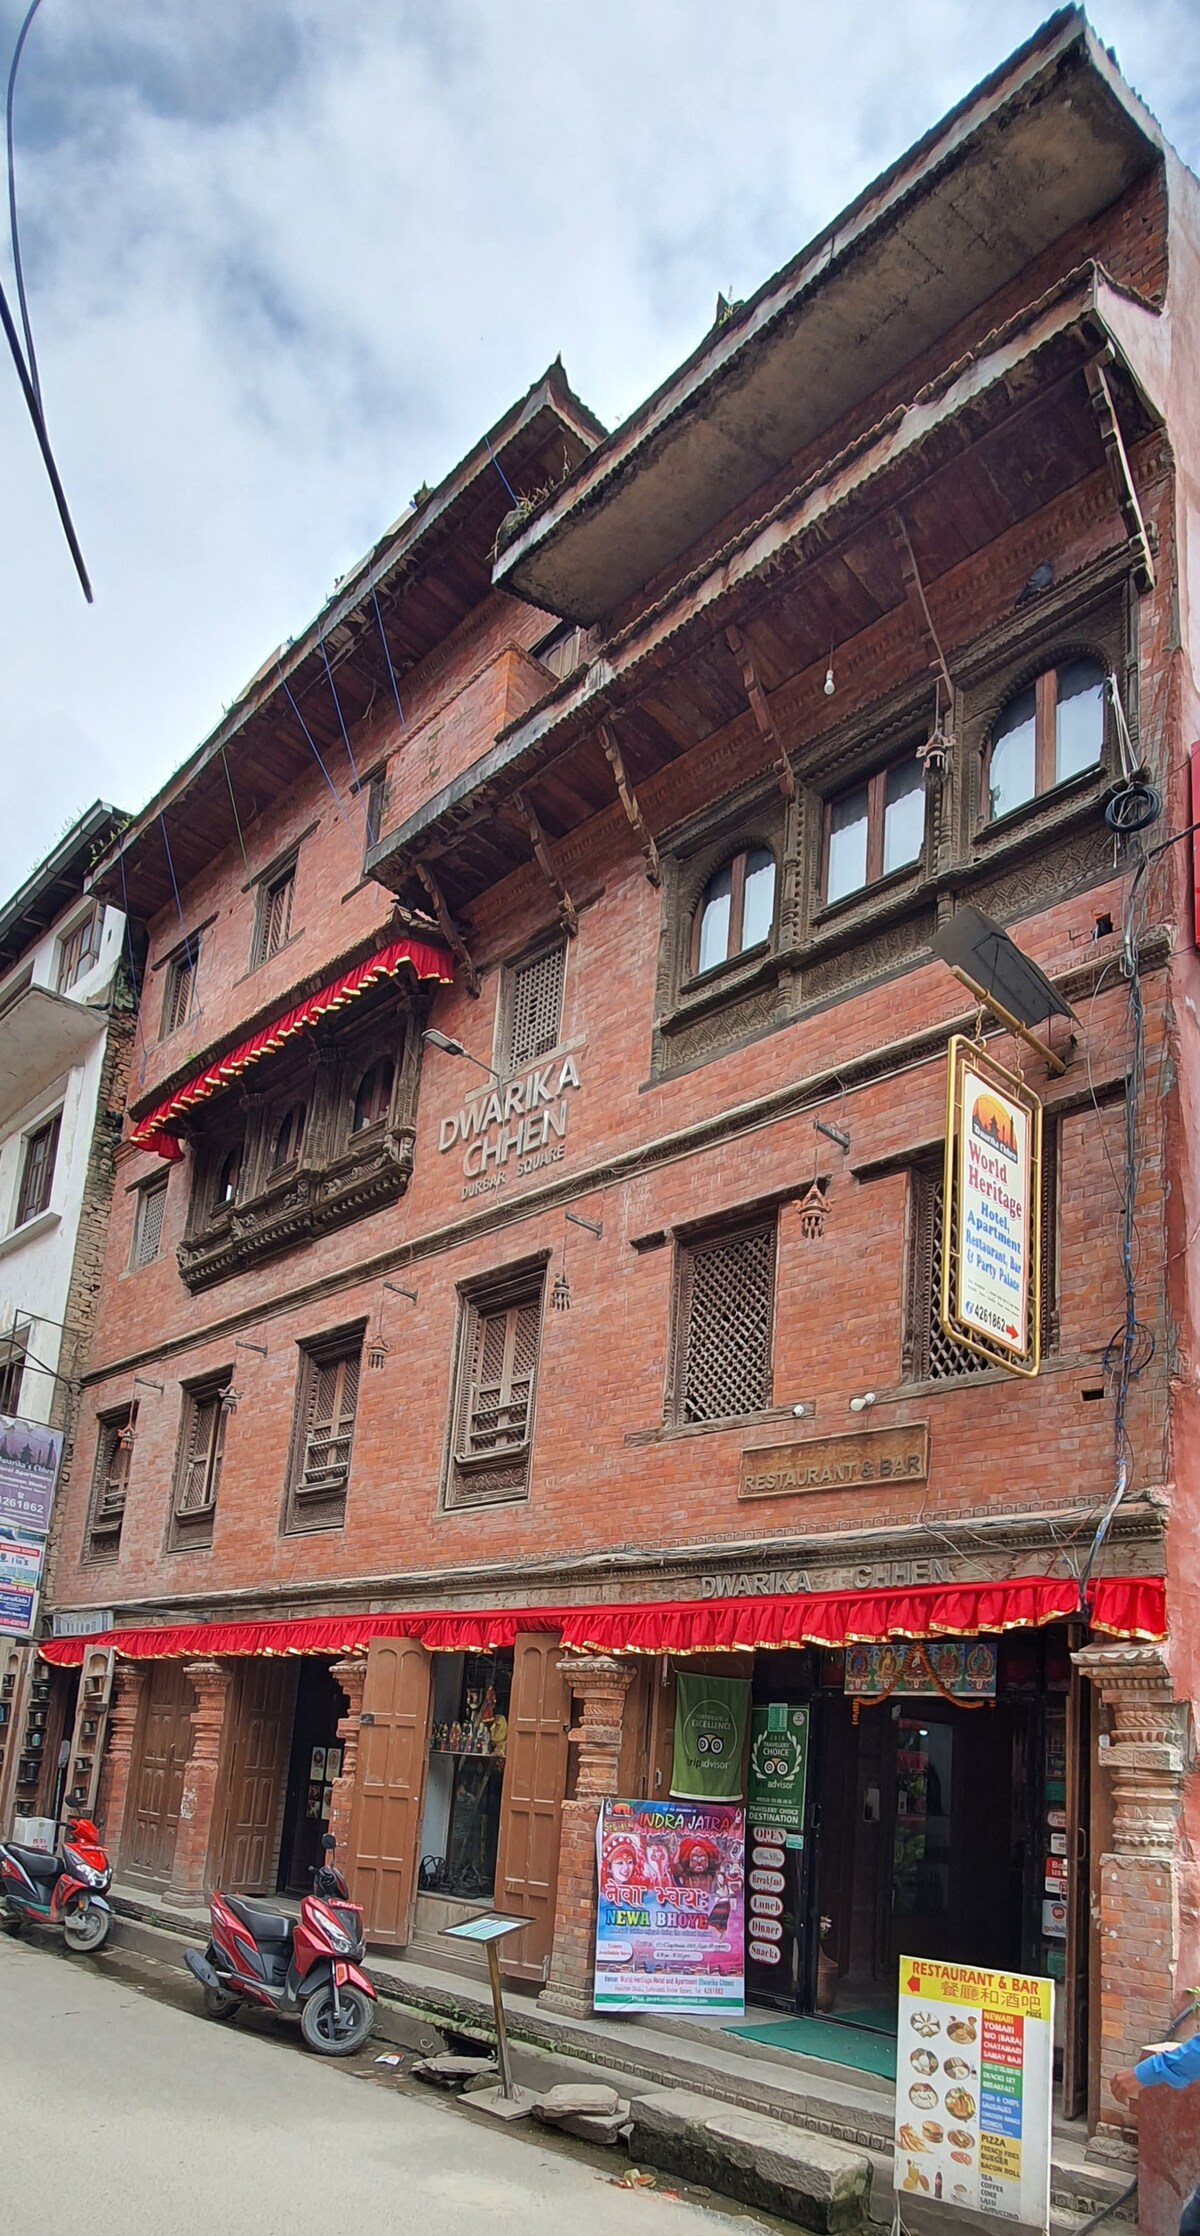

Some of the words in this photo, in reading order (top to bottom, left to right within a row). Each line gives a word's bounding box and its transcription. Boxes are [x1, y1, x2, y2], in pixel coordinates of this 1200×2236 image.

[439, 1055, 581, 1152] DWARIKA
[463, 1100, 567, 1177] CHHEN
[968, 1139, 1008, 1184] World
[461, 1171, 506, 1200] DURBAR
[517, 1144, 565, 1177] SQUARE
[968, 1164, 1022, 1219] Heritage
[981, 1201, 1010, 1233] Hotel,
[967, 1210, 1021, 1254] Apartment
[965, 1229, 1007, 1267] Restaurant,
[1009, 1256, 1021, 1275] Bar
[976, 1253, 997, 1280] Party
[999, 1267, 1020, 1292] Palace
[974, 1305, 1006, 1333] 4261862
[743, 1463, 856, 1492] RESTAURANT
[861, 1461, 873, 1478] &
[879, 1454, 921, 1477] BAR
[701, 1571, 812, 1598] DWARIKA
[853, 1558, 950, 1589] CHHEN
[763, 1748, 790, 1757] CHOICE
[687, 1757, 729, 1770] tripadvisor
[639, 1812, 684, 1830] INDRA
[687, 1815, 731, 1833] JATRA
[749, 1812, 799, 1824] DESTINATION
[756, 1828, 784, 1841] OPEN
[752, 1873, 782, 1887] Breakfast
[753, 1897, 781, 1912] Lunch
[606, 1909, 650, 1927] NEWA
[656, 1911, 709, 1930] BHOYE
[752, 1920, 779, 1935] Dinner
[751, 1944, 778, 1959] Snacks
[912, 1961, 994, 1987] RESTAURANT
[998, 1976, 1007, 1991] &
[1012, 1978, 1039, 1995] BAR
[941, 1980, 1042, 2012] 餐廳和酒吧
[984, 2011, 1014, 2024] NEWARI
[1025, 2010, 1042, 2019] PRICE
[984, 2021, 1014, 2034] YOMARI
[984, 2031, 996, 2040] WO
[983, 2051, 1006, 2061] SAMAY
[1007, 2055, 1022, 2065] BAJI
[981, 2133, 1006, 2148] PIZZA
[980, 2153, 1009, 2166] BURGER
[981, 2145, 1003, 2157] FRENCH
[1004, 2150, 1020, 2160] FRIES
[980, 2162, 1003, 2173] BACON
[1004, 2168, 1021, 2179] ROLL
[981, 2173, 993, 2182] TEA
[980, 2181, 1004, 2193] COFFEE
[980, 2189, 997, 2199] COKE
[980, 2196, 997, 2206] LASSI
